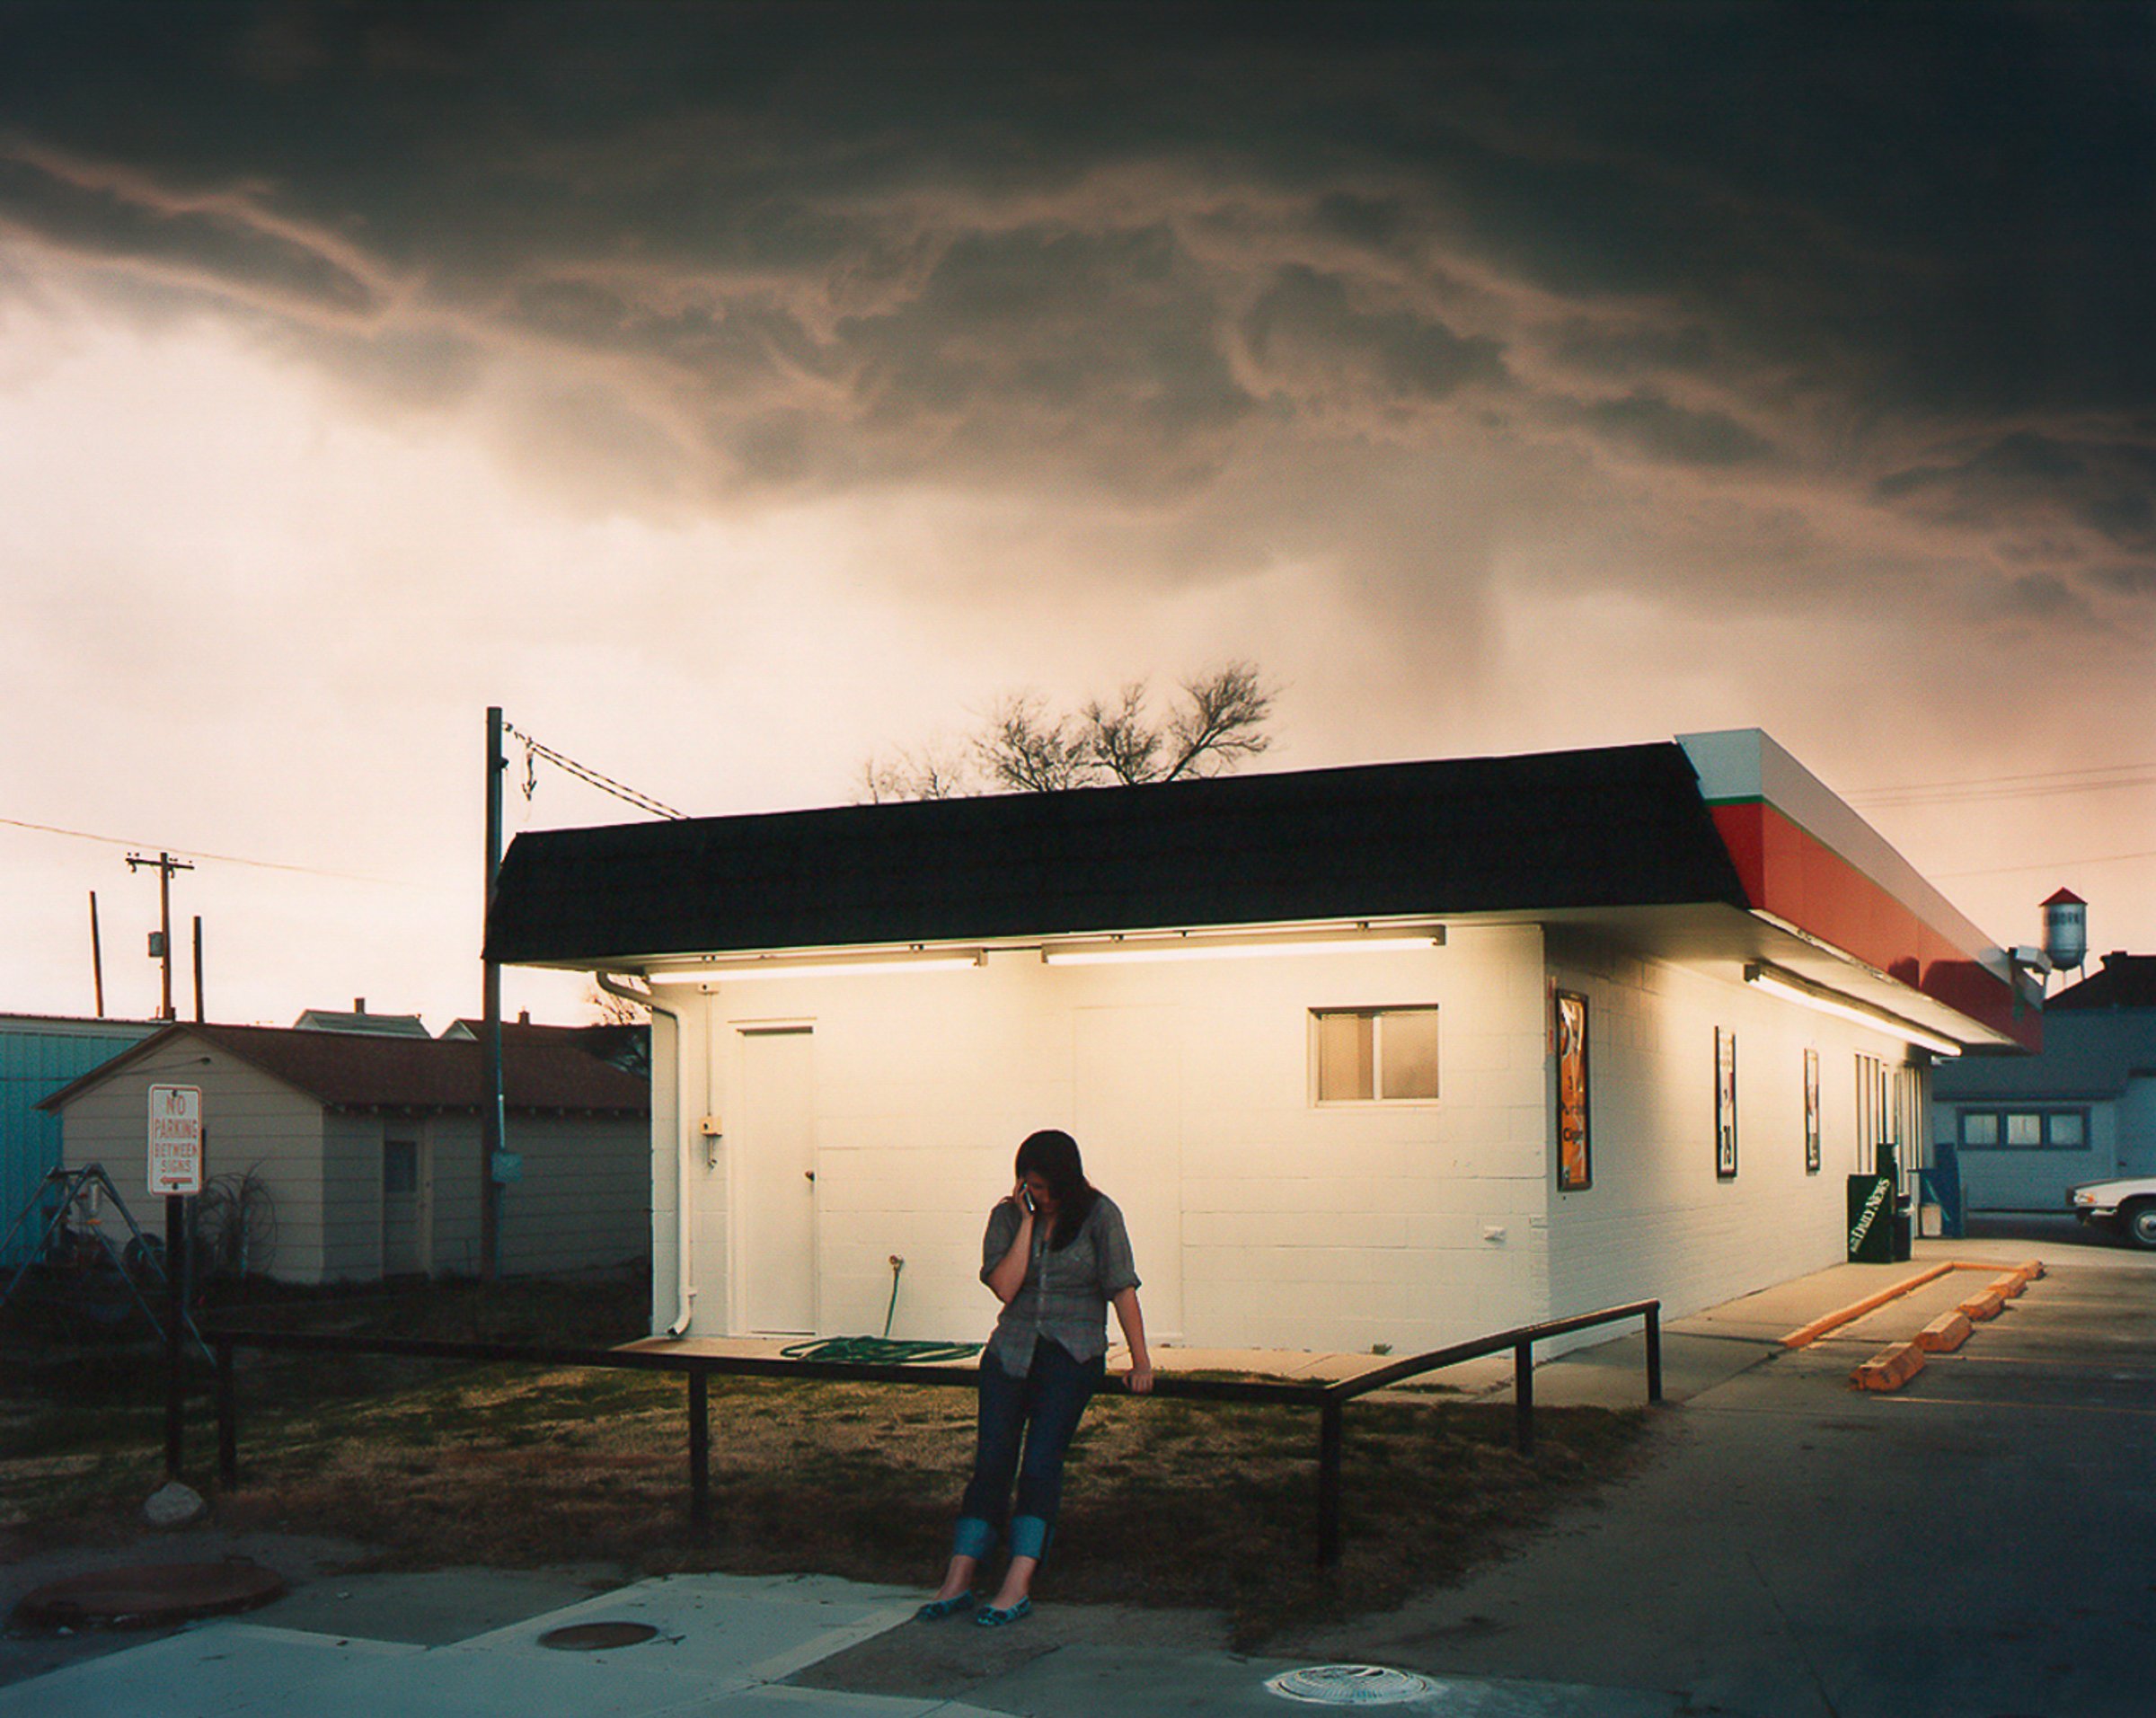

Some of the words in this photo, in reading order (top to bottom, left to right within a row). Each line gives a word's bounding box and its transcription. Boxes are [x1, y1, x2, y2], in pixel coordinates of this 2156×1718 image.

[166, 1094, 186, 1115] NO
[155, 1118, 198, 1138] PARKING
[155, 1142, 198, 1158] BETWEEN
[161, 1159, 190, 1173] SIGNS
